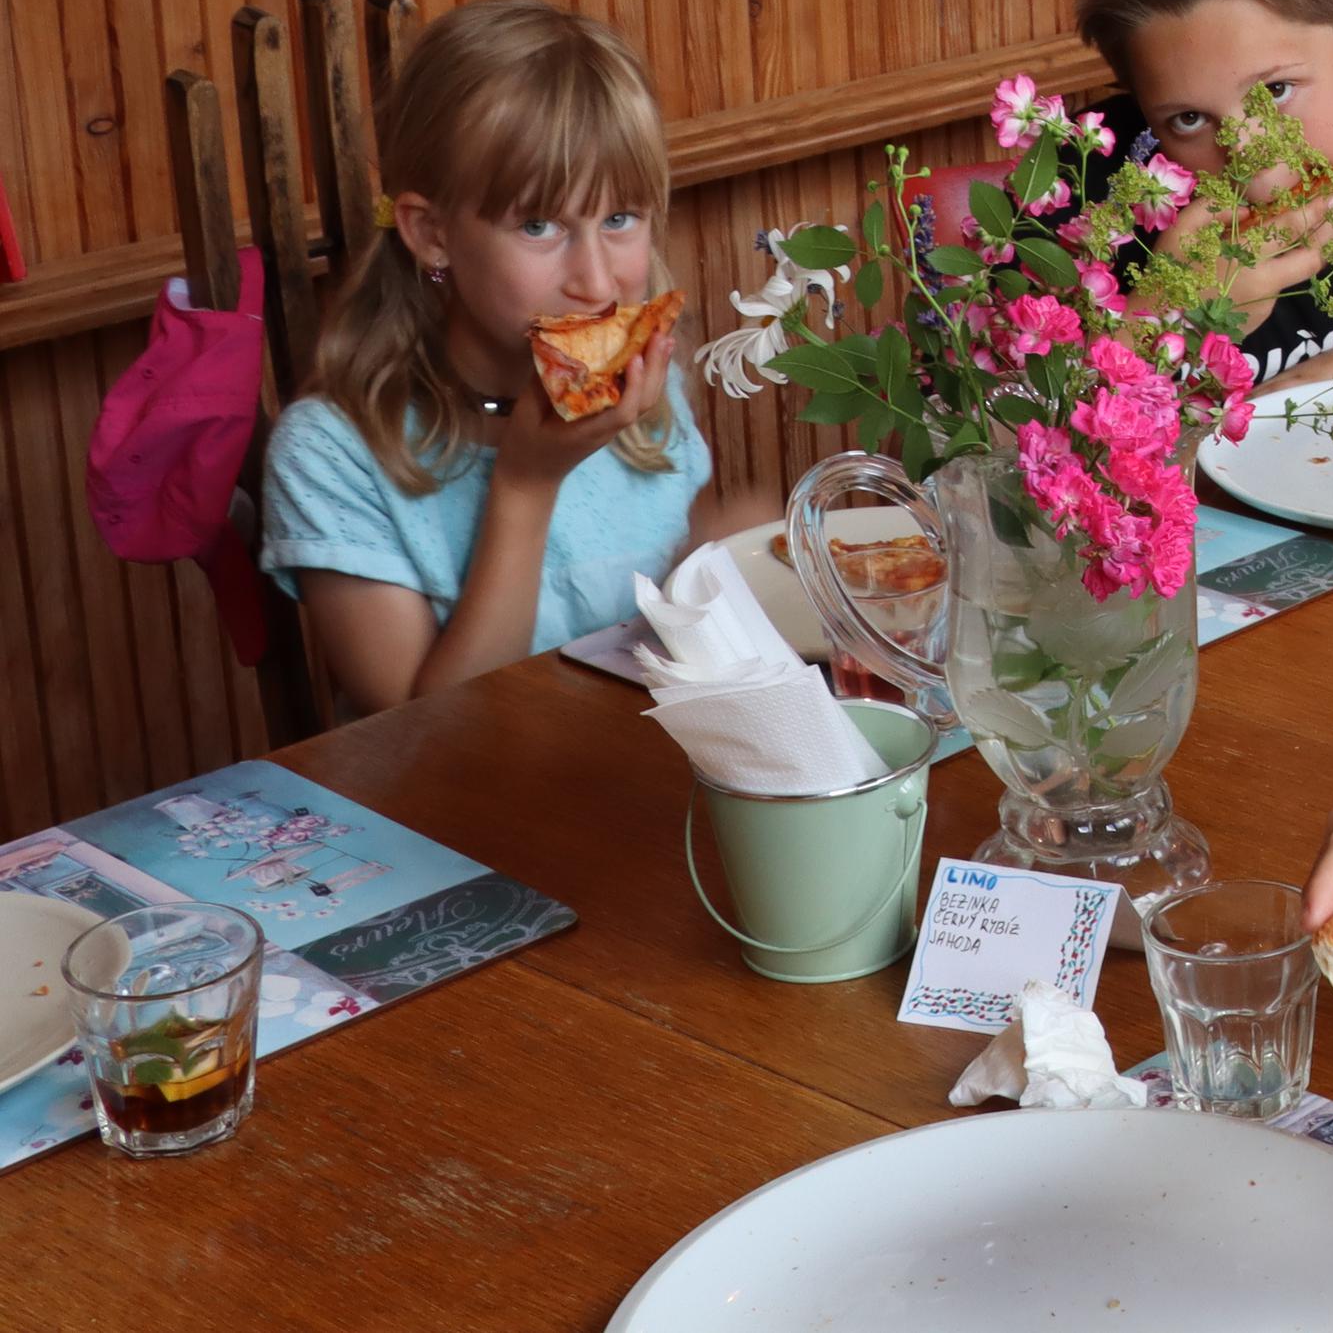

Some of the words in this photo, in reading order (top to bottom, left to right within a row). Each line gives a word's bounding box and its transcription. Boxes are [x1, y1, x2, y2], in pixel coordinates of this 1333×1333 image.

[947, 868, 998, 891] LIMO
[939, 892, 1000, 913] BEZINKA
[933, 907, 978, 929] ČERNÝ
[979, 915, 1021, 936] RYBÍZ
[928, 930, 982, 955] JAHODA
